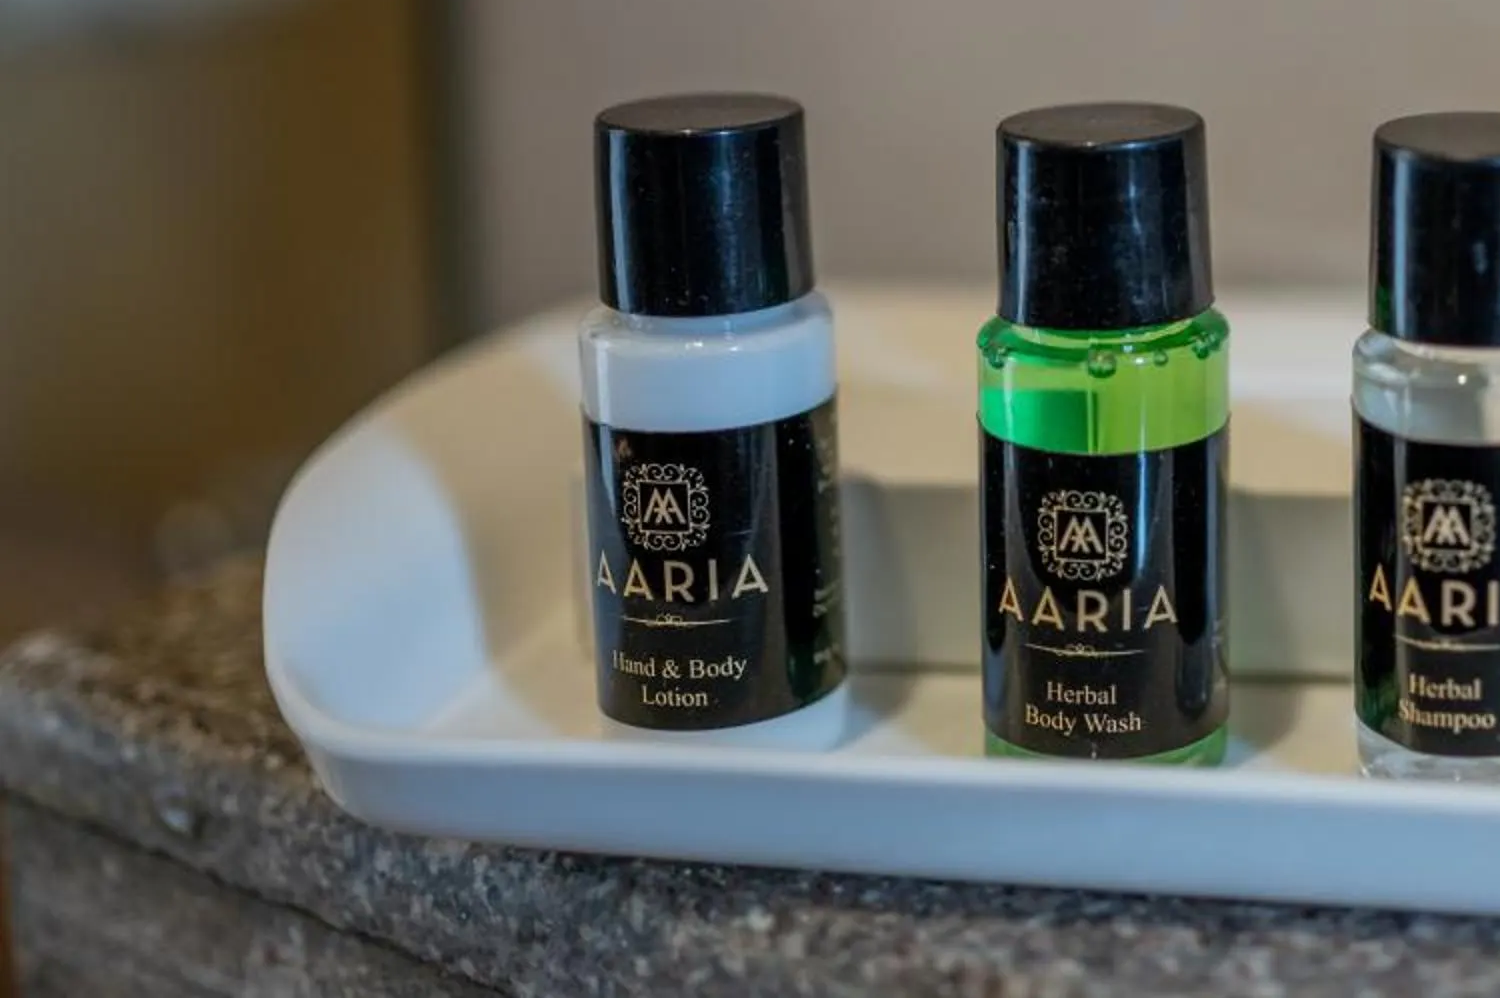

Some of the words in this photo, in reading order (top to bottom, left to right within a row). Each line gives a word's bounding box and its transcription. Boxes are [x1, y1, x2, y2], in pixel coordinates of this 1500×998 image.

[597, 549, 769, 602] AARIA
[998, 576, 1179, 632] AARIA
[612, 649, 656, 678] Hand
[662, 660, 682, 679] &
[690, 656, 748, 682] Body
[642, 686, 709, 707] Lotion
[1047, 681, 1117, 705] Herbal
[1408, 673, 1482, 699] Herbal
[1025, 704, 1077, 736] Body
[1085, 711, 1142, 733] Wash
[1398, 698, 1497, 733] Shampoo
